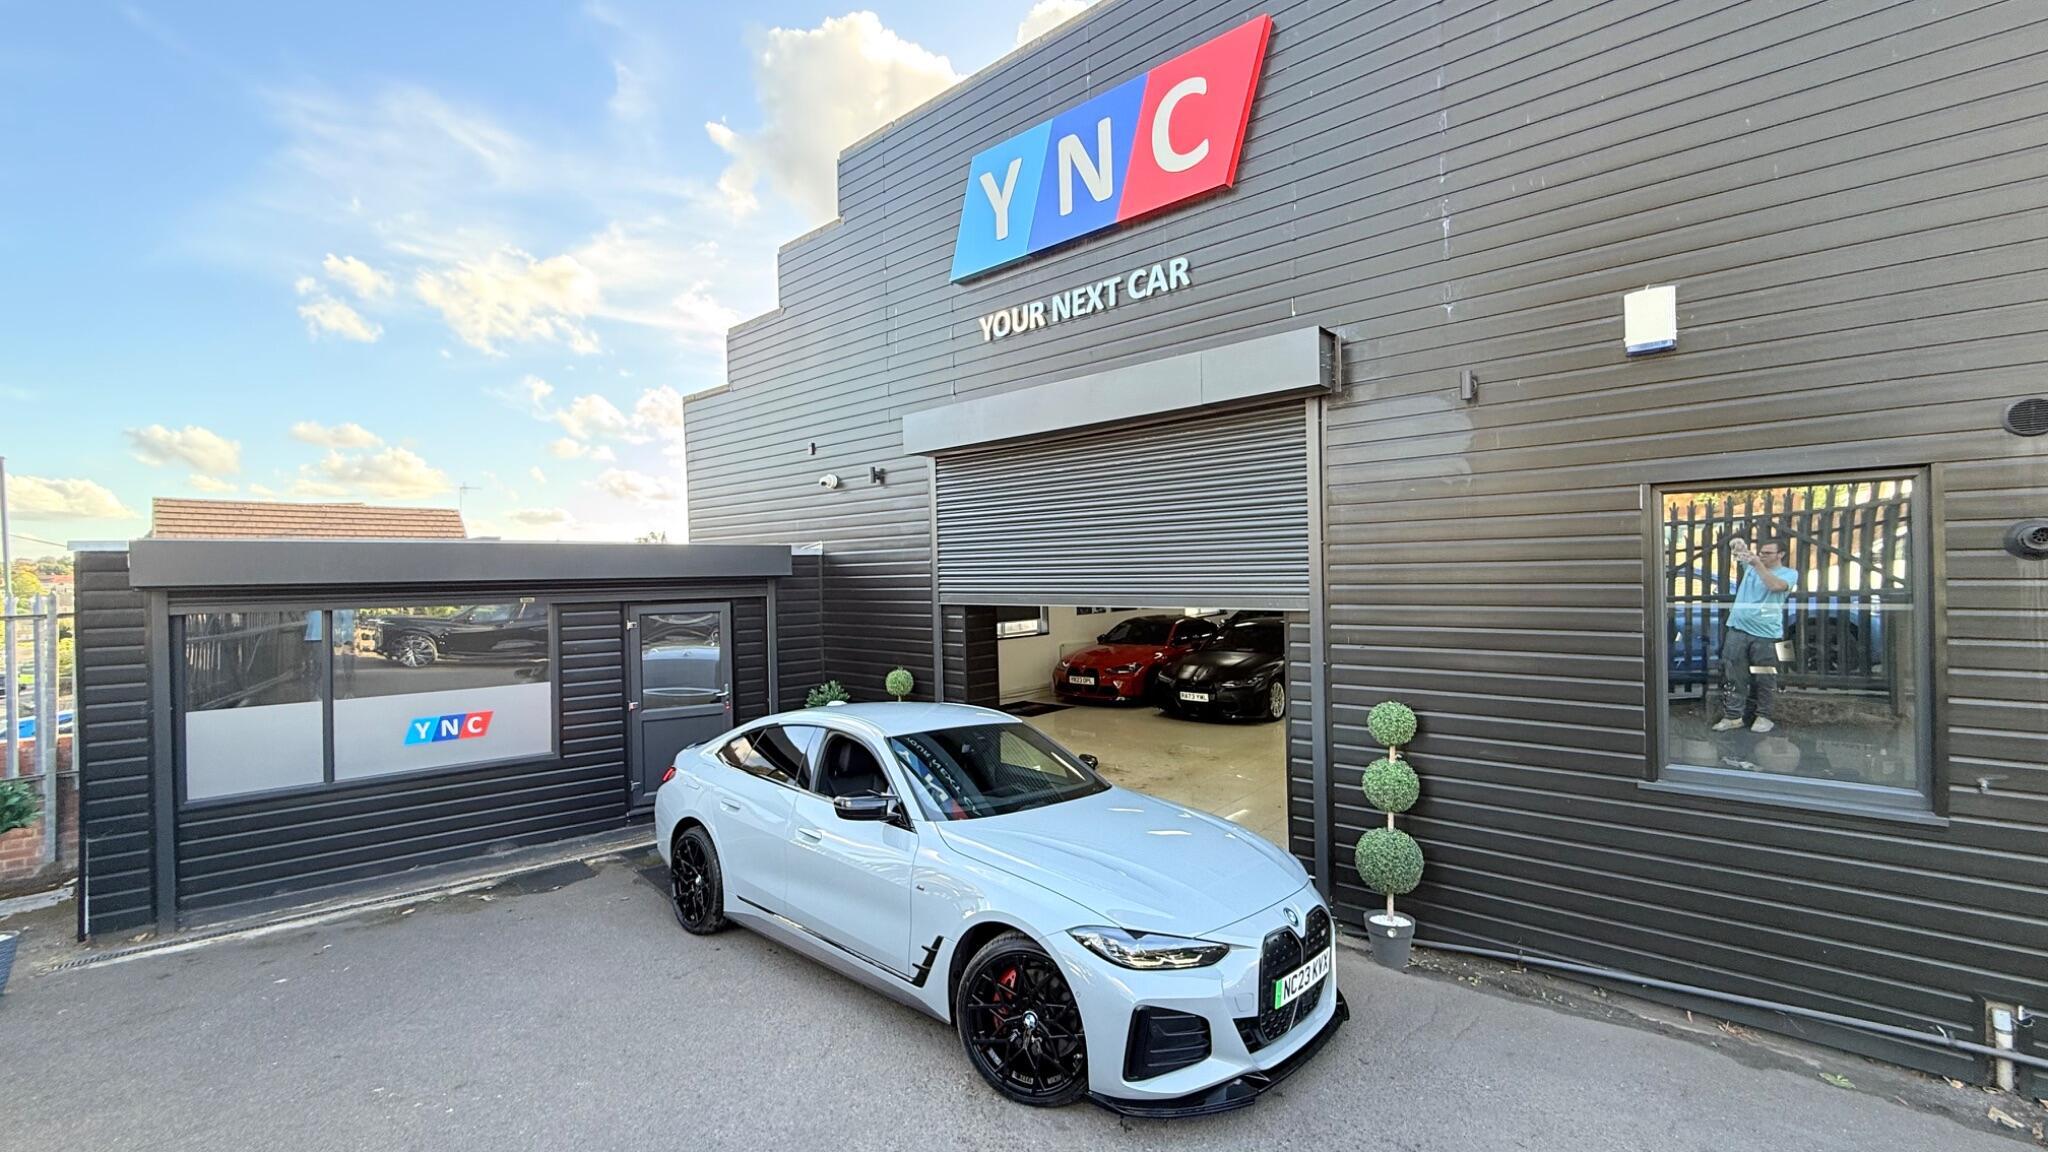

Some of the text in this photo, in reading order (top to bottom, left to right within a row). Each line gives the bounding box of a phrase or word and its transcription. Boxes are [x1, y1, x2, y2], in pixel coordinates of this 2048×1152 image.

[979, 76, 1210, 241] YNC
[979, 257, 1190, 342] YOUR NEXT CAR
[414, 716, 483, 739] YNC
[1283, 950, 1329, 1000] NC23 KVX
